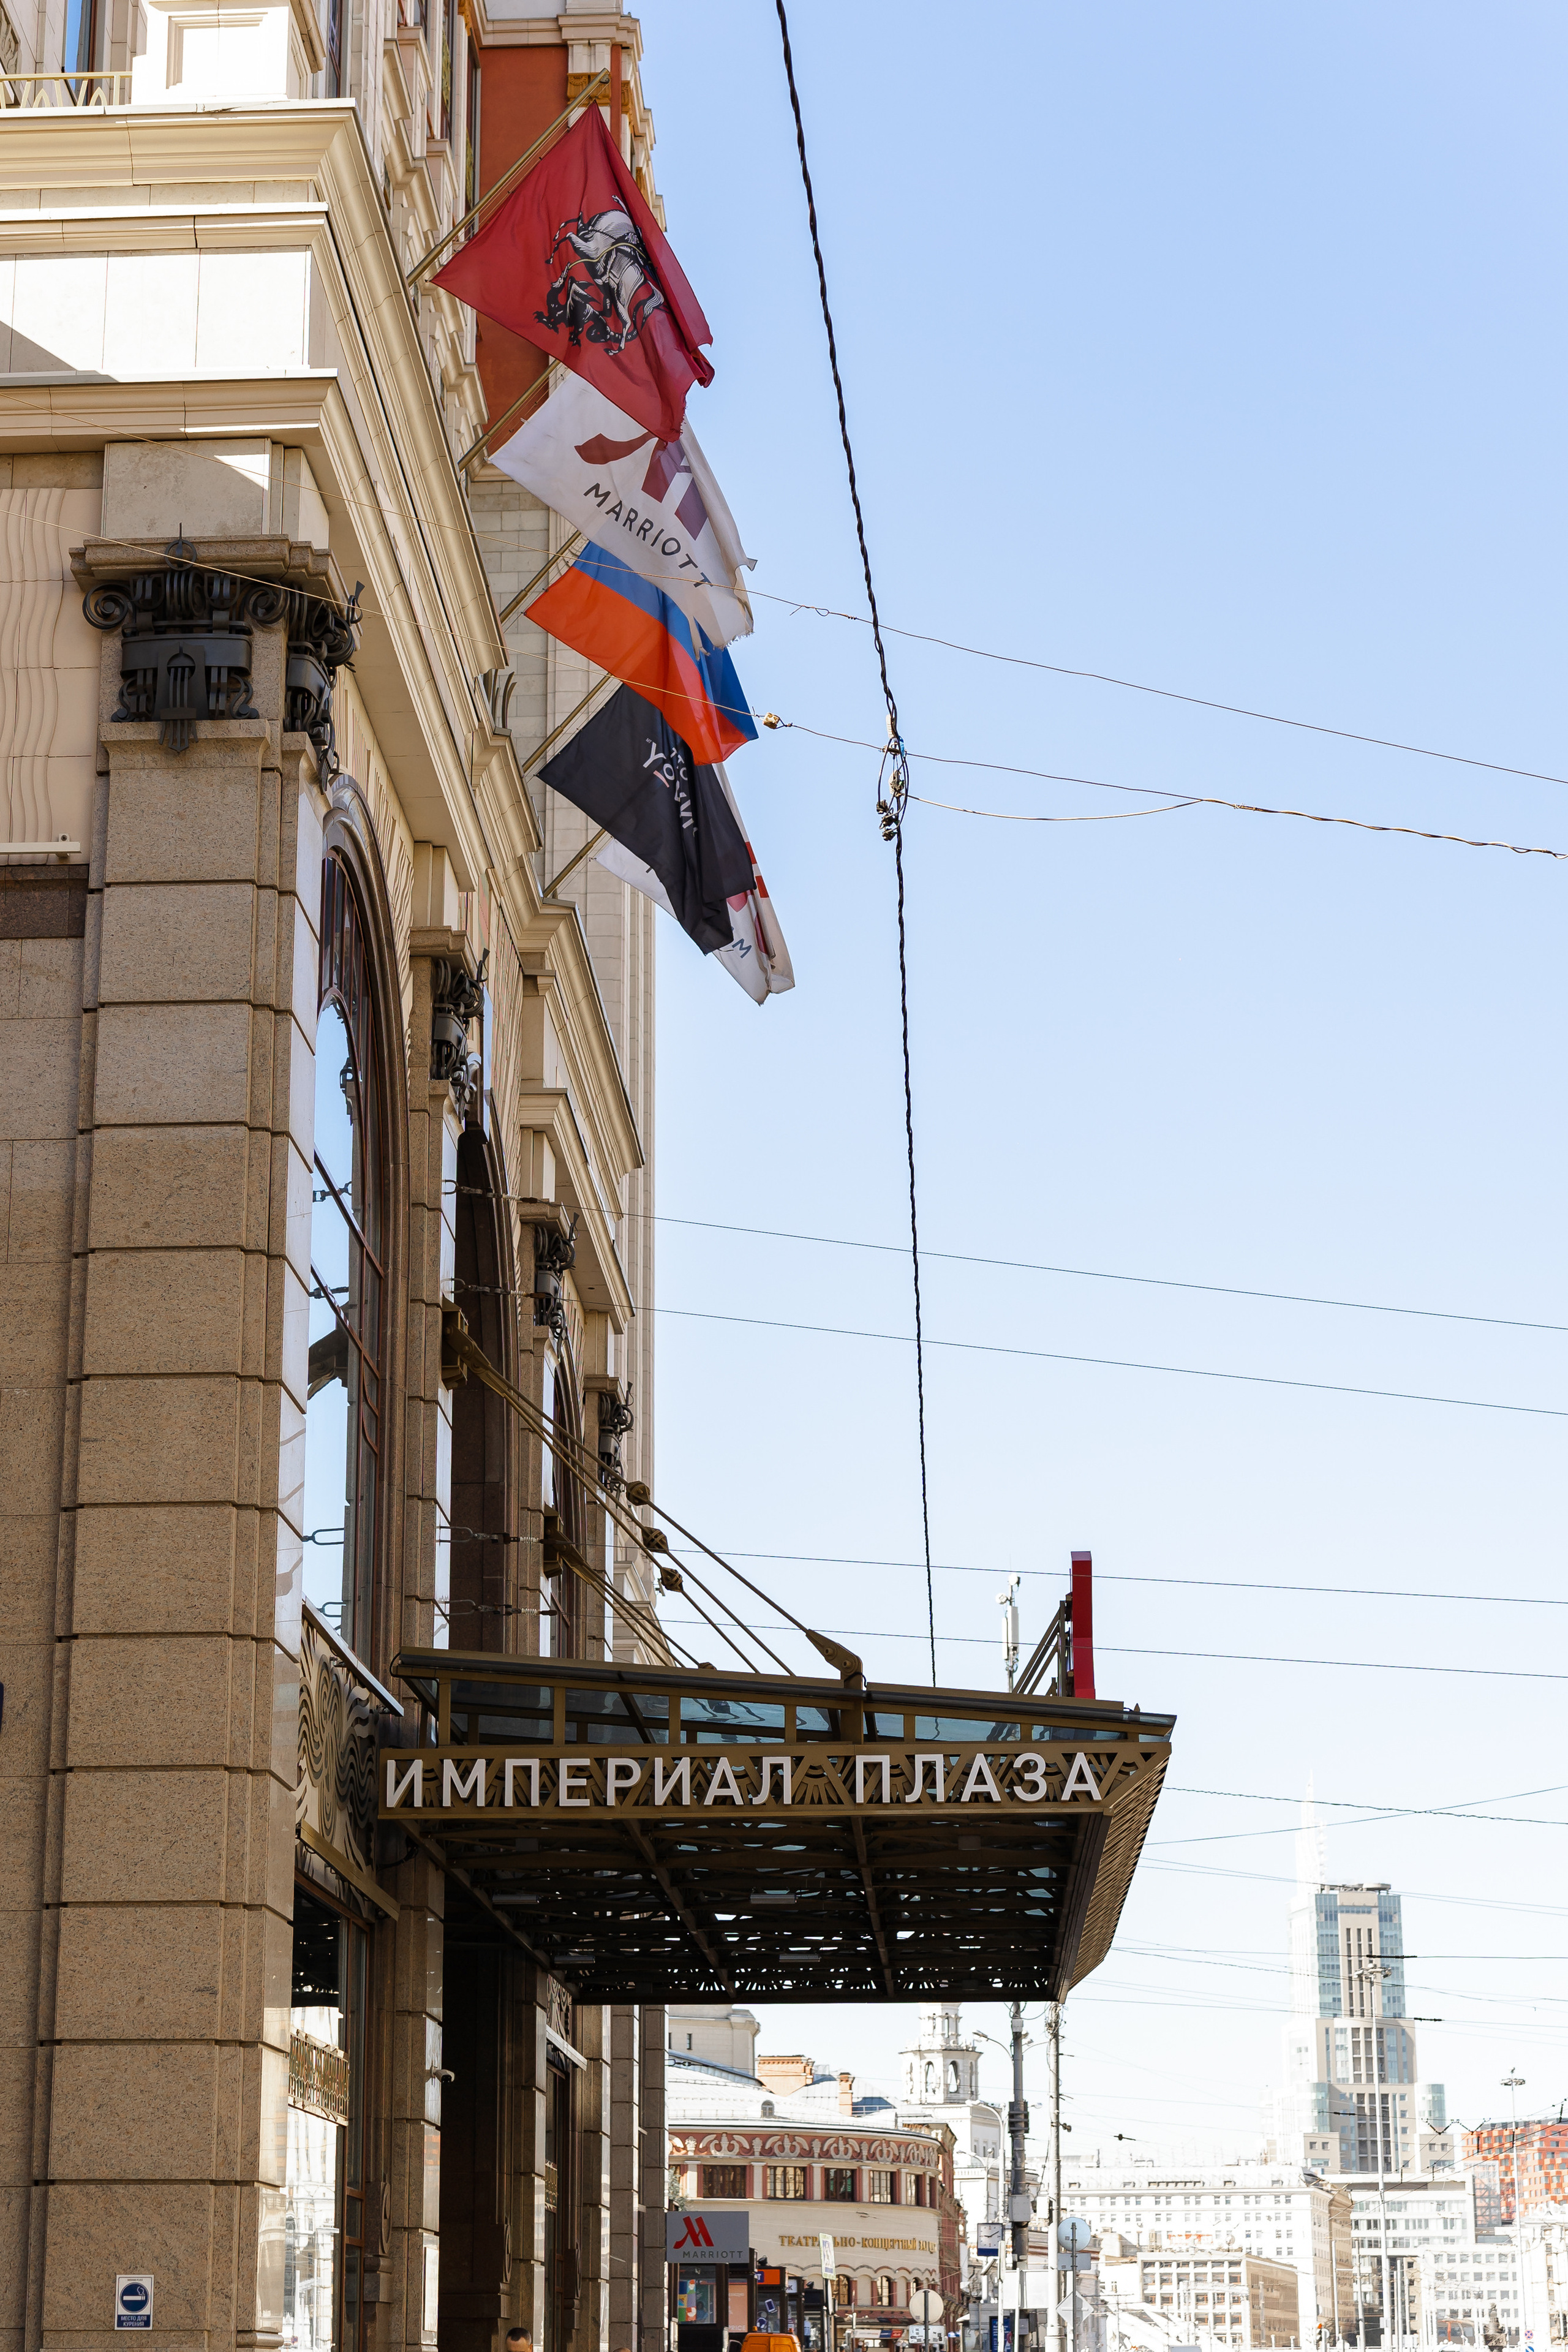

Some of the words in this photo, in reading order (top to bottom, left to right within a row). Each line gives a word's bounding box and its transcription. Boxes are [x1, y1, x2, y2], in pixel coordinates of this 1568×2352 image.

[584, 483, 714, 589] MARRIOTT
[386, 1756, 792, 1807] ИМПЕРИАЛ
[856, 1752, 1102, 1803] ПЛАЗА
